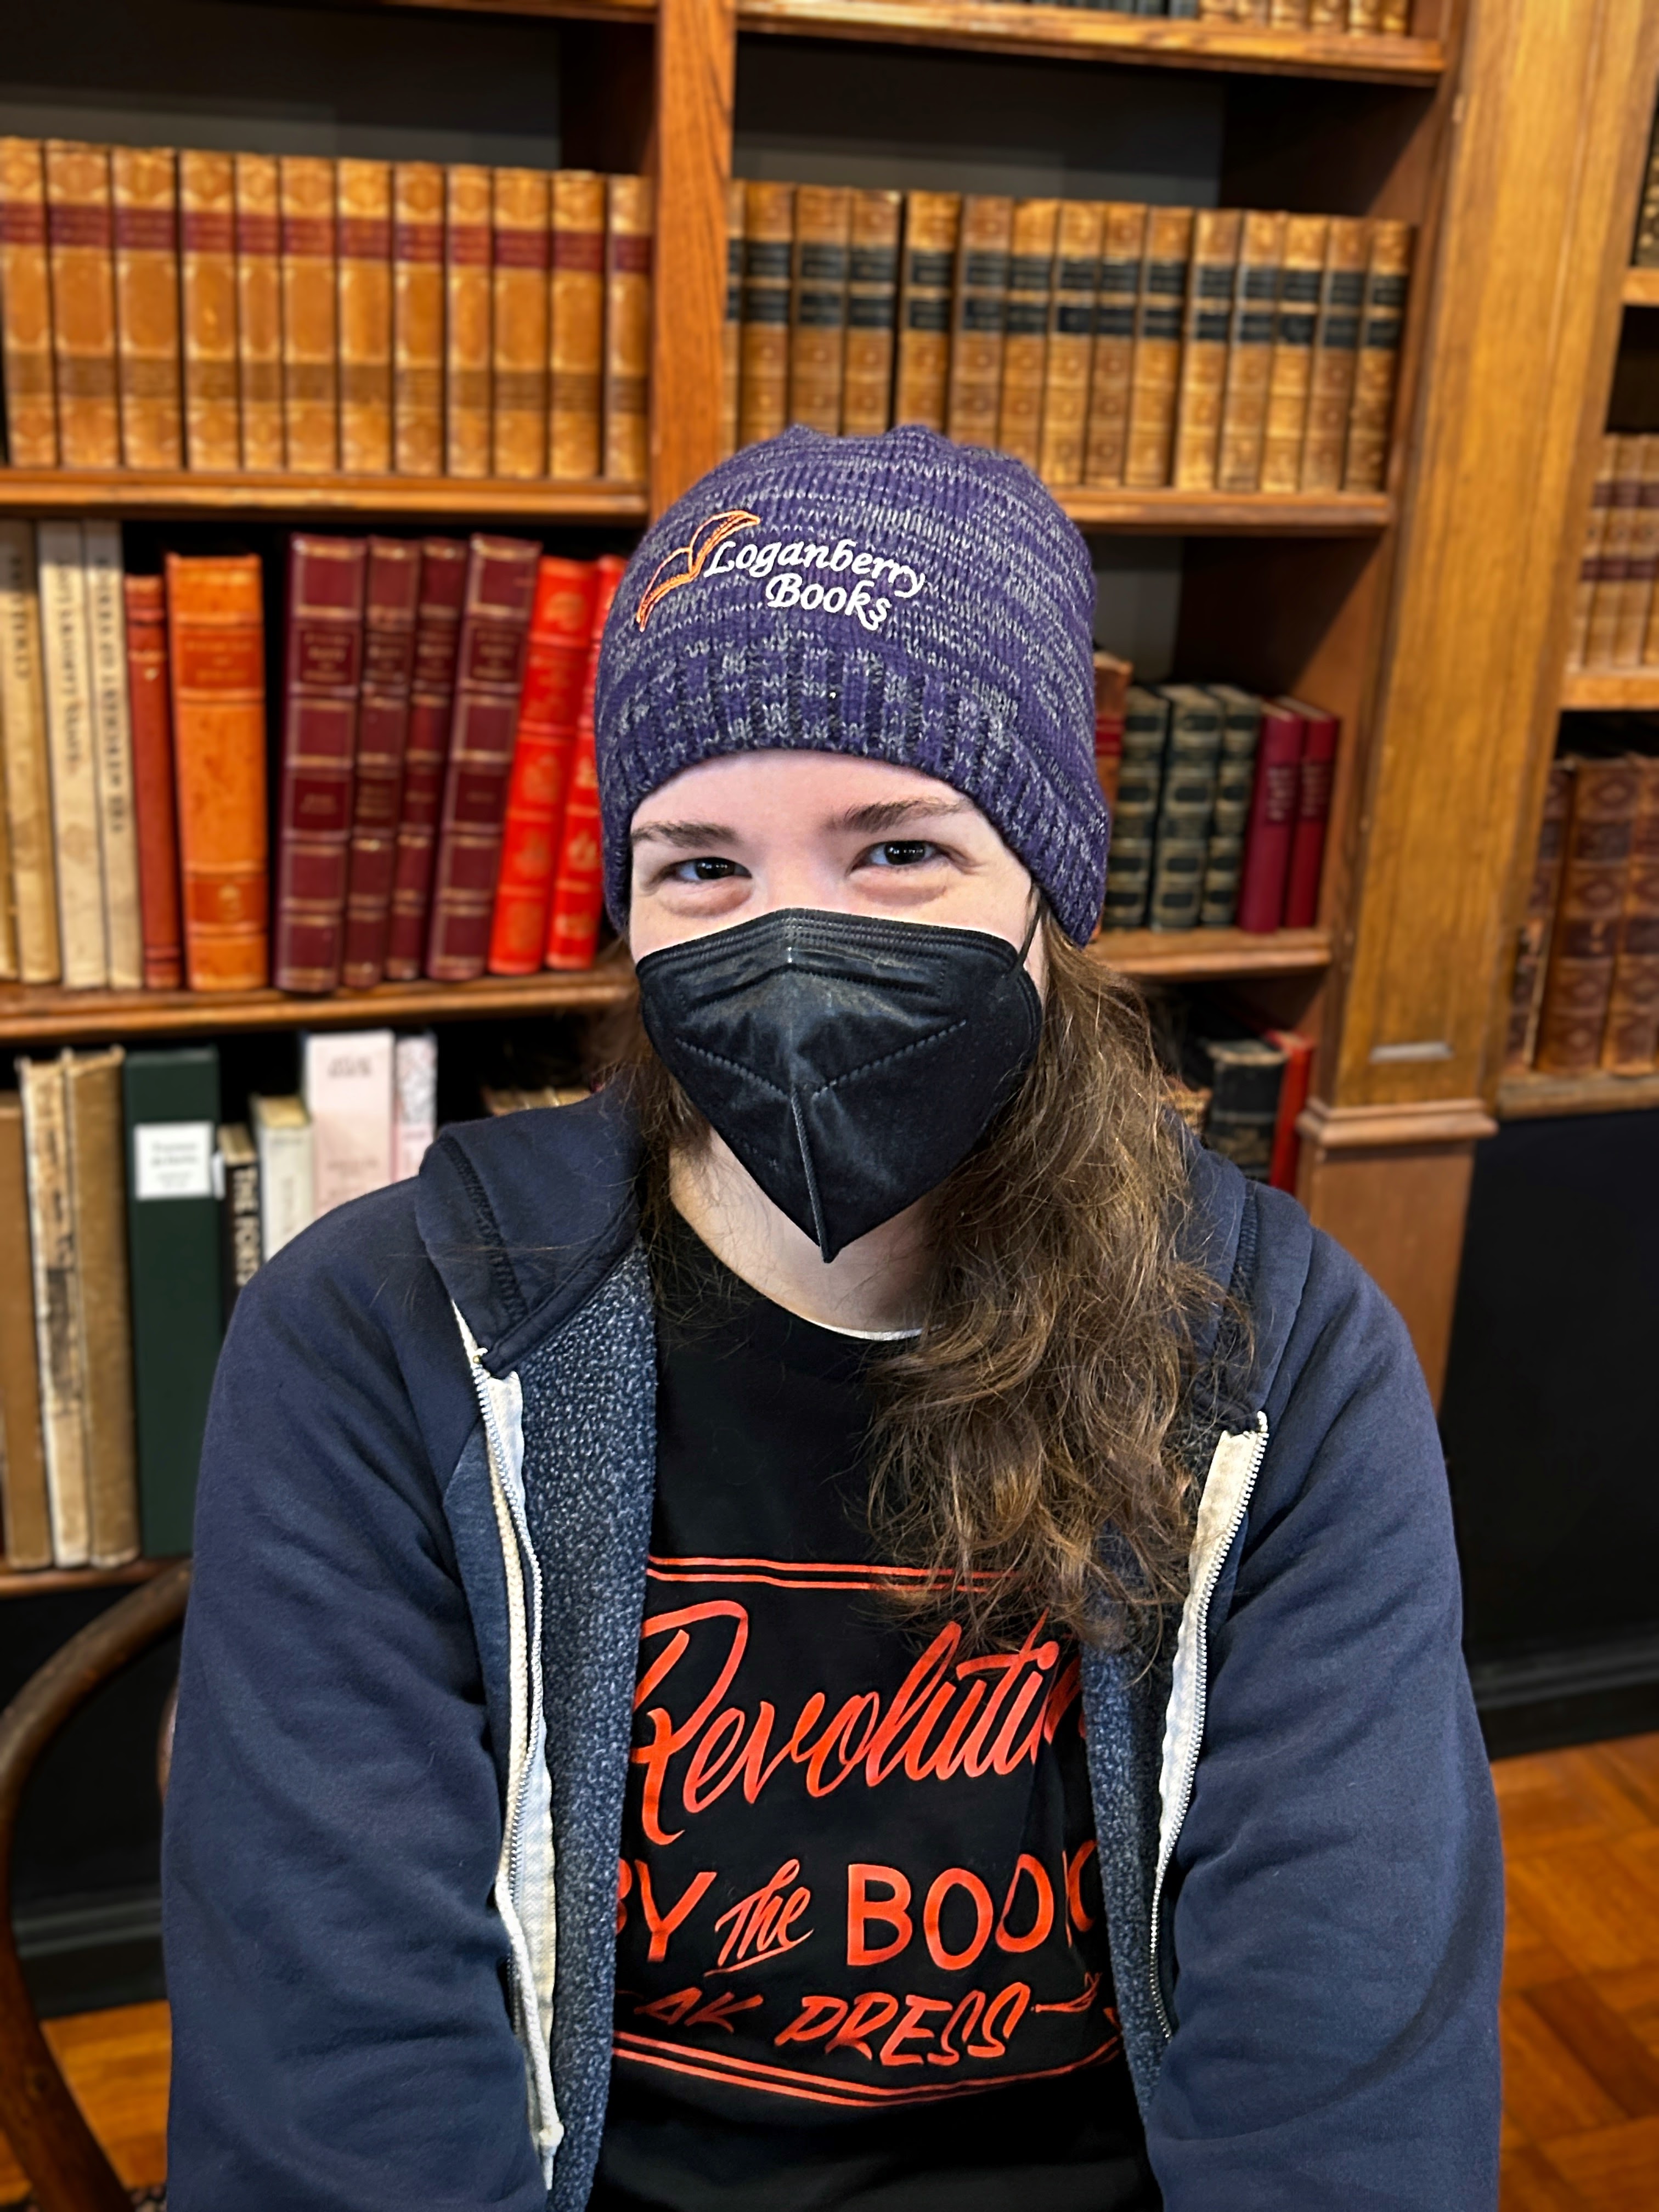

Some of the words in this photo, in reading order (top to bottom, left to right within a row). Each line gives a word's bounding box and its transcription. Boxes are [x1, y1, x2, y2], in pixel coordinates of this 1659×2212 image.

[703, 538, 926, 600] Loganberry
[765, 572, 892, 632] Books
[630, 1600, 1082, 1846] Revoluti
[774, 1981, 1031, 2067] PRESS
